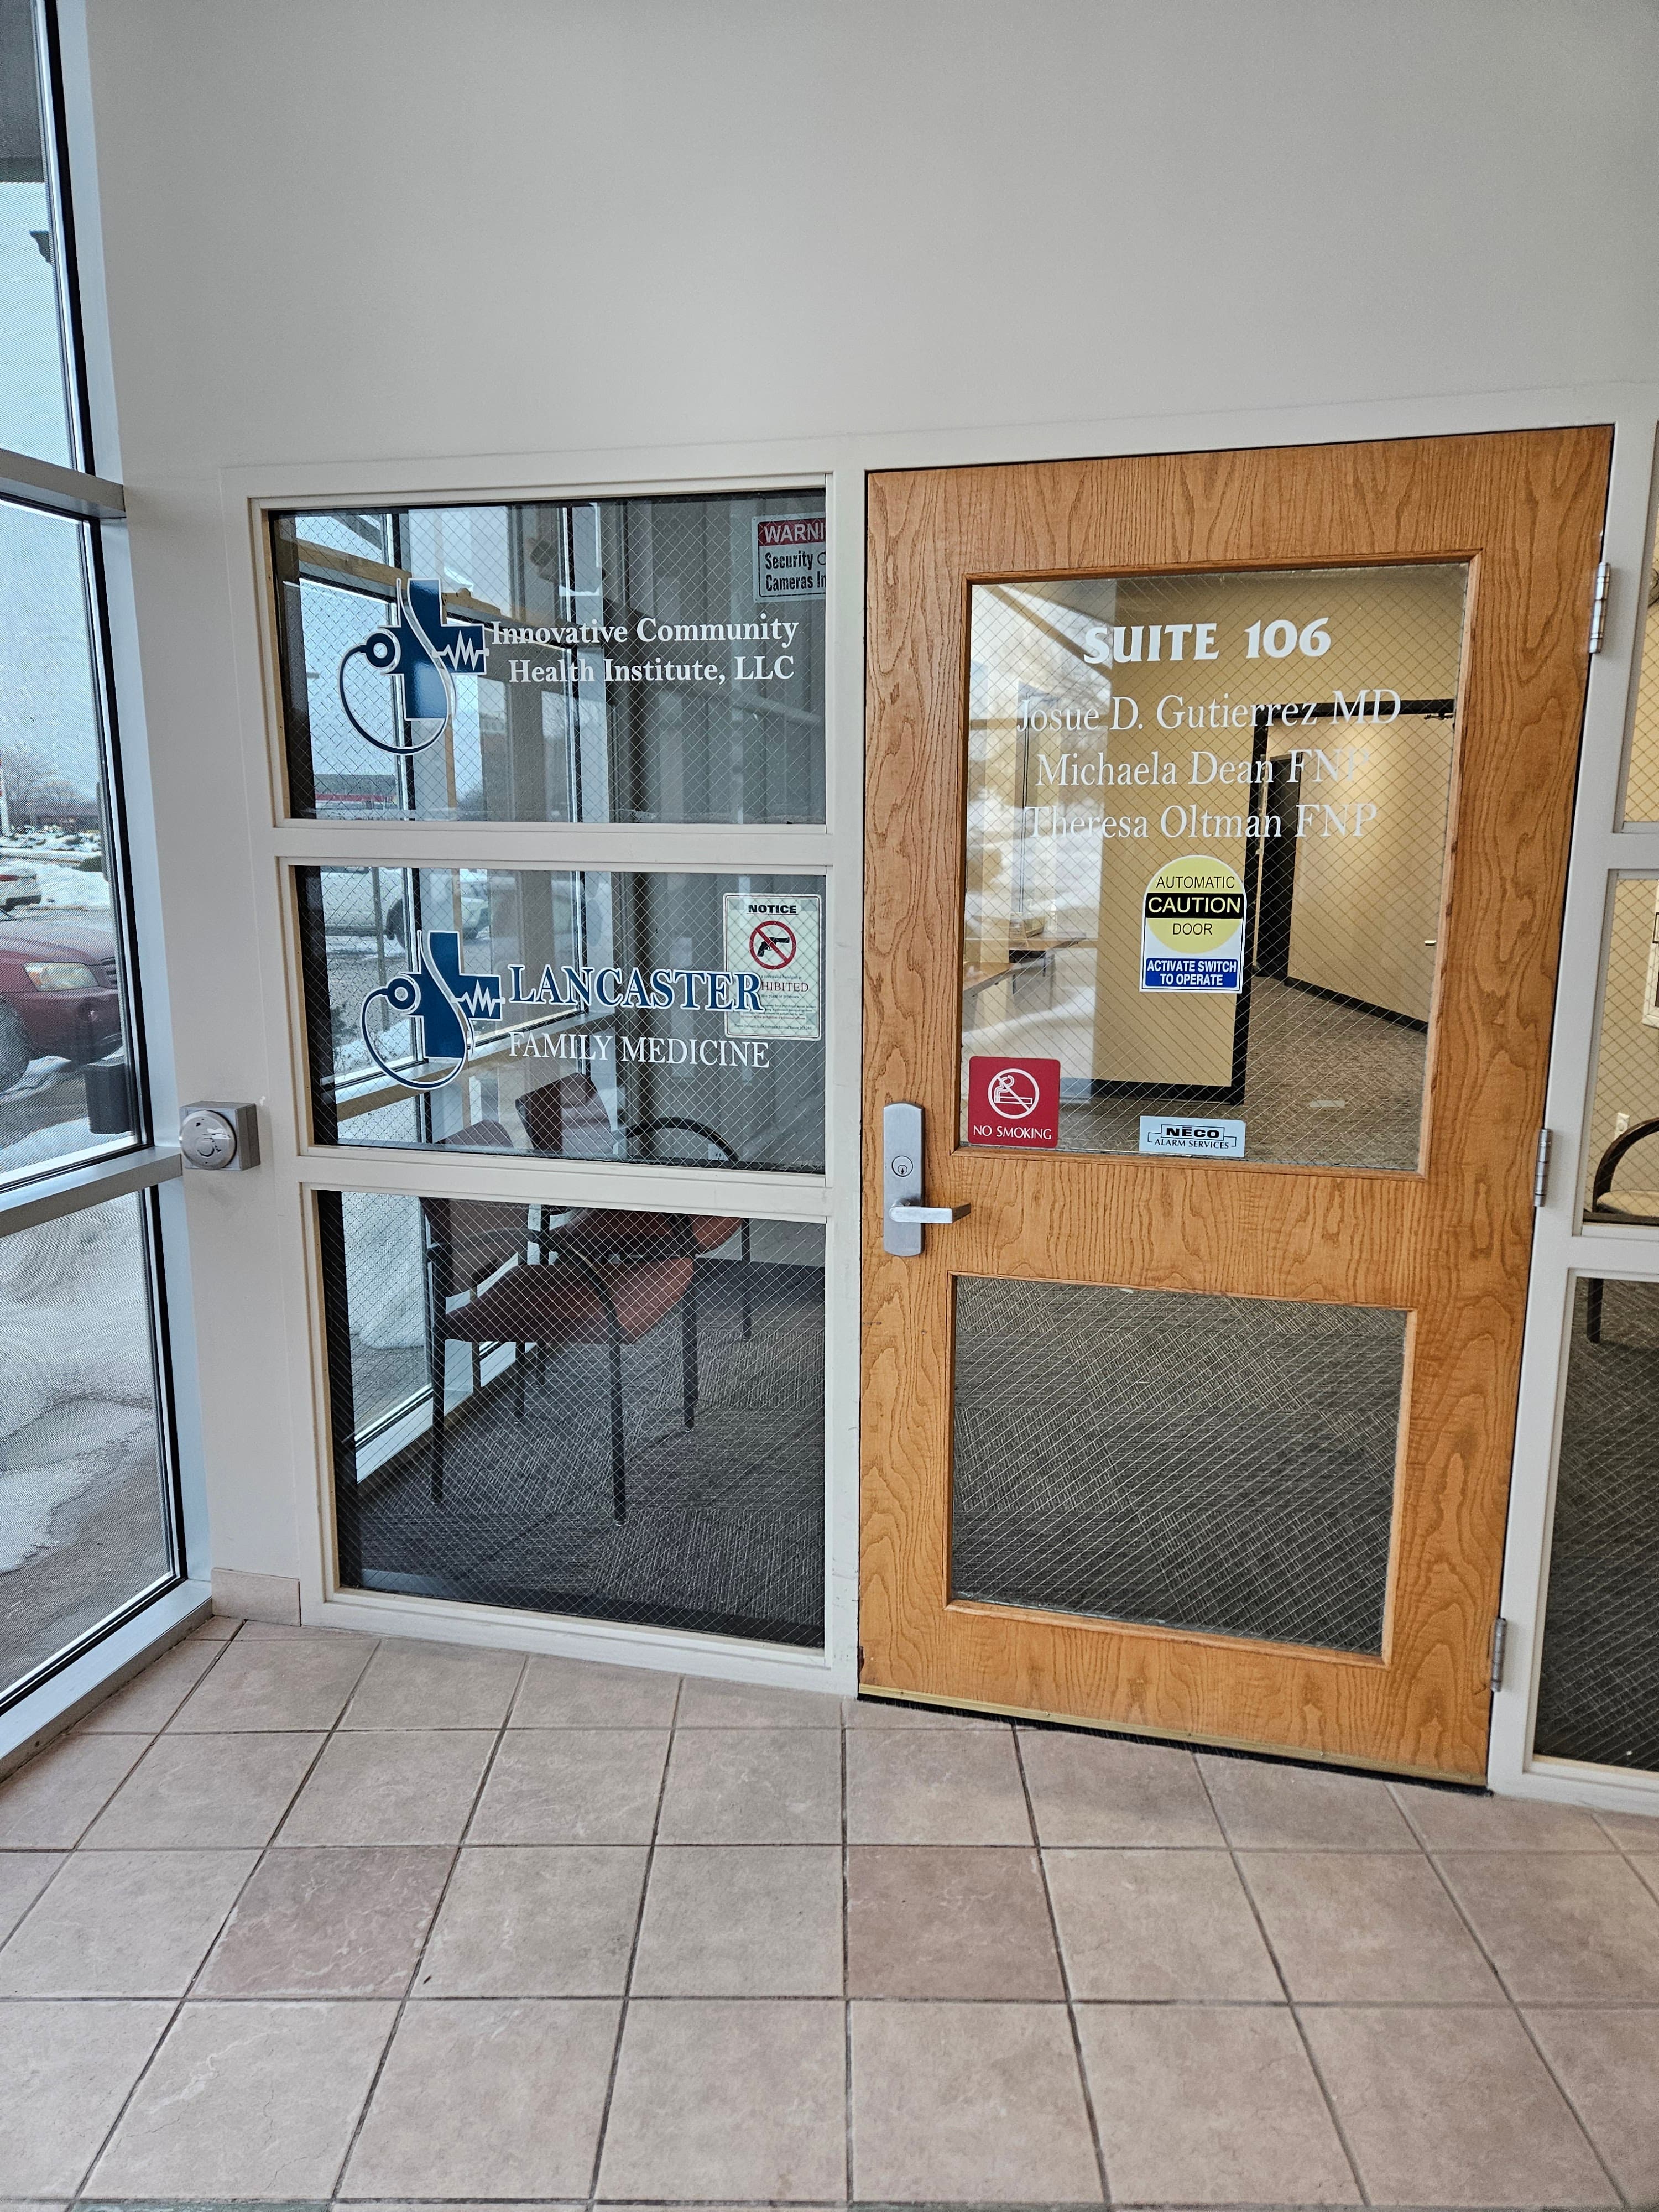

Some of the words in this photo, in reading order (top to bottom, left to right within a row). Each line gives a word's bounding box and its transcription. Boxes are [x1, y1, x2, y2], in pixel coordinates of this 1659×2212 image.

[764, 523, 824, 543] WARNI
[765, 551, 813, 570] Security
[765, 575, 813, 591] Cameras
[491, 618, 628, 645] Innovative
[637, 613, 799, 648] Community
[1083, 623, 1219, 664] SUITE
[1244, 617, 1332, 659] 106
[508, 658, 595, 683] Health
[604, 657, 726, 685] Institute,
[734, 655, 795, 680] LLC
[1017, 698, 1099, 732] Josue
[1109, 696, 1144, 731] D.
[1156, 692, 1316, 730] Gutierrez
[1329, 688, 1401, 726] MD
[1035, 750, 1177, 786] Michaela
[1187, 750, 1274, 785] Dean
[1289, 748, 1369, 784] FNP
[1024, 804, 1149, 838] Theresa
[1160, 804, 1282, 838] Oltman
[1296, 802, 1378, 838] FNP
[1156, 876, 1235, 889] AUTOMATIC
[748, 905, 797, 914] NOTICE
[1148, 897, 1240, 913] CAUTION
[1172, 923, 1212, 935] DOOR
[1147, 960, 1195, 972] ACTIVATE
[1198, 961, 1237, 973] SWITCH
[761, 982, 809, 992] HIBITED
[1160, 974, 1173, 985] TO
[1176, 974, 1223, 985] OPERATE
[508, 964, 765, 1013] LANCASTER
[509, 1032, 614, 1061] FAMILY
[620, 1036, 770, 1068] MEDICINE
[973, 1125, 992, 1136] NO
[997, 1126, 1052, 1140] SMOKING
[1166, 1126, 1219, 1138] NECO
[1154, 1139, 1186, 1147] ALARM
[1188, 1140, 1229, 1149] SERVICES
